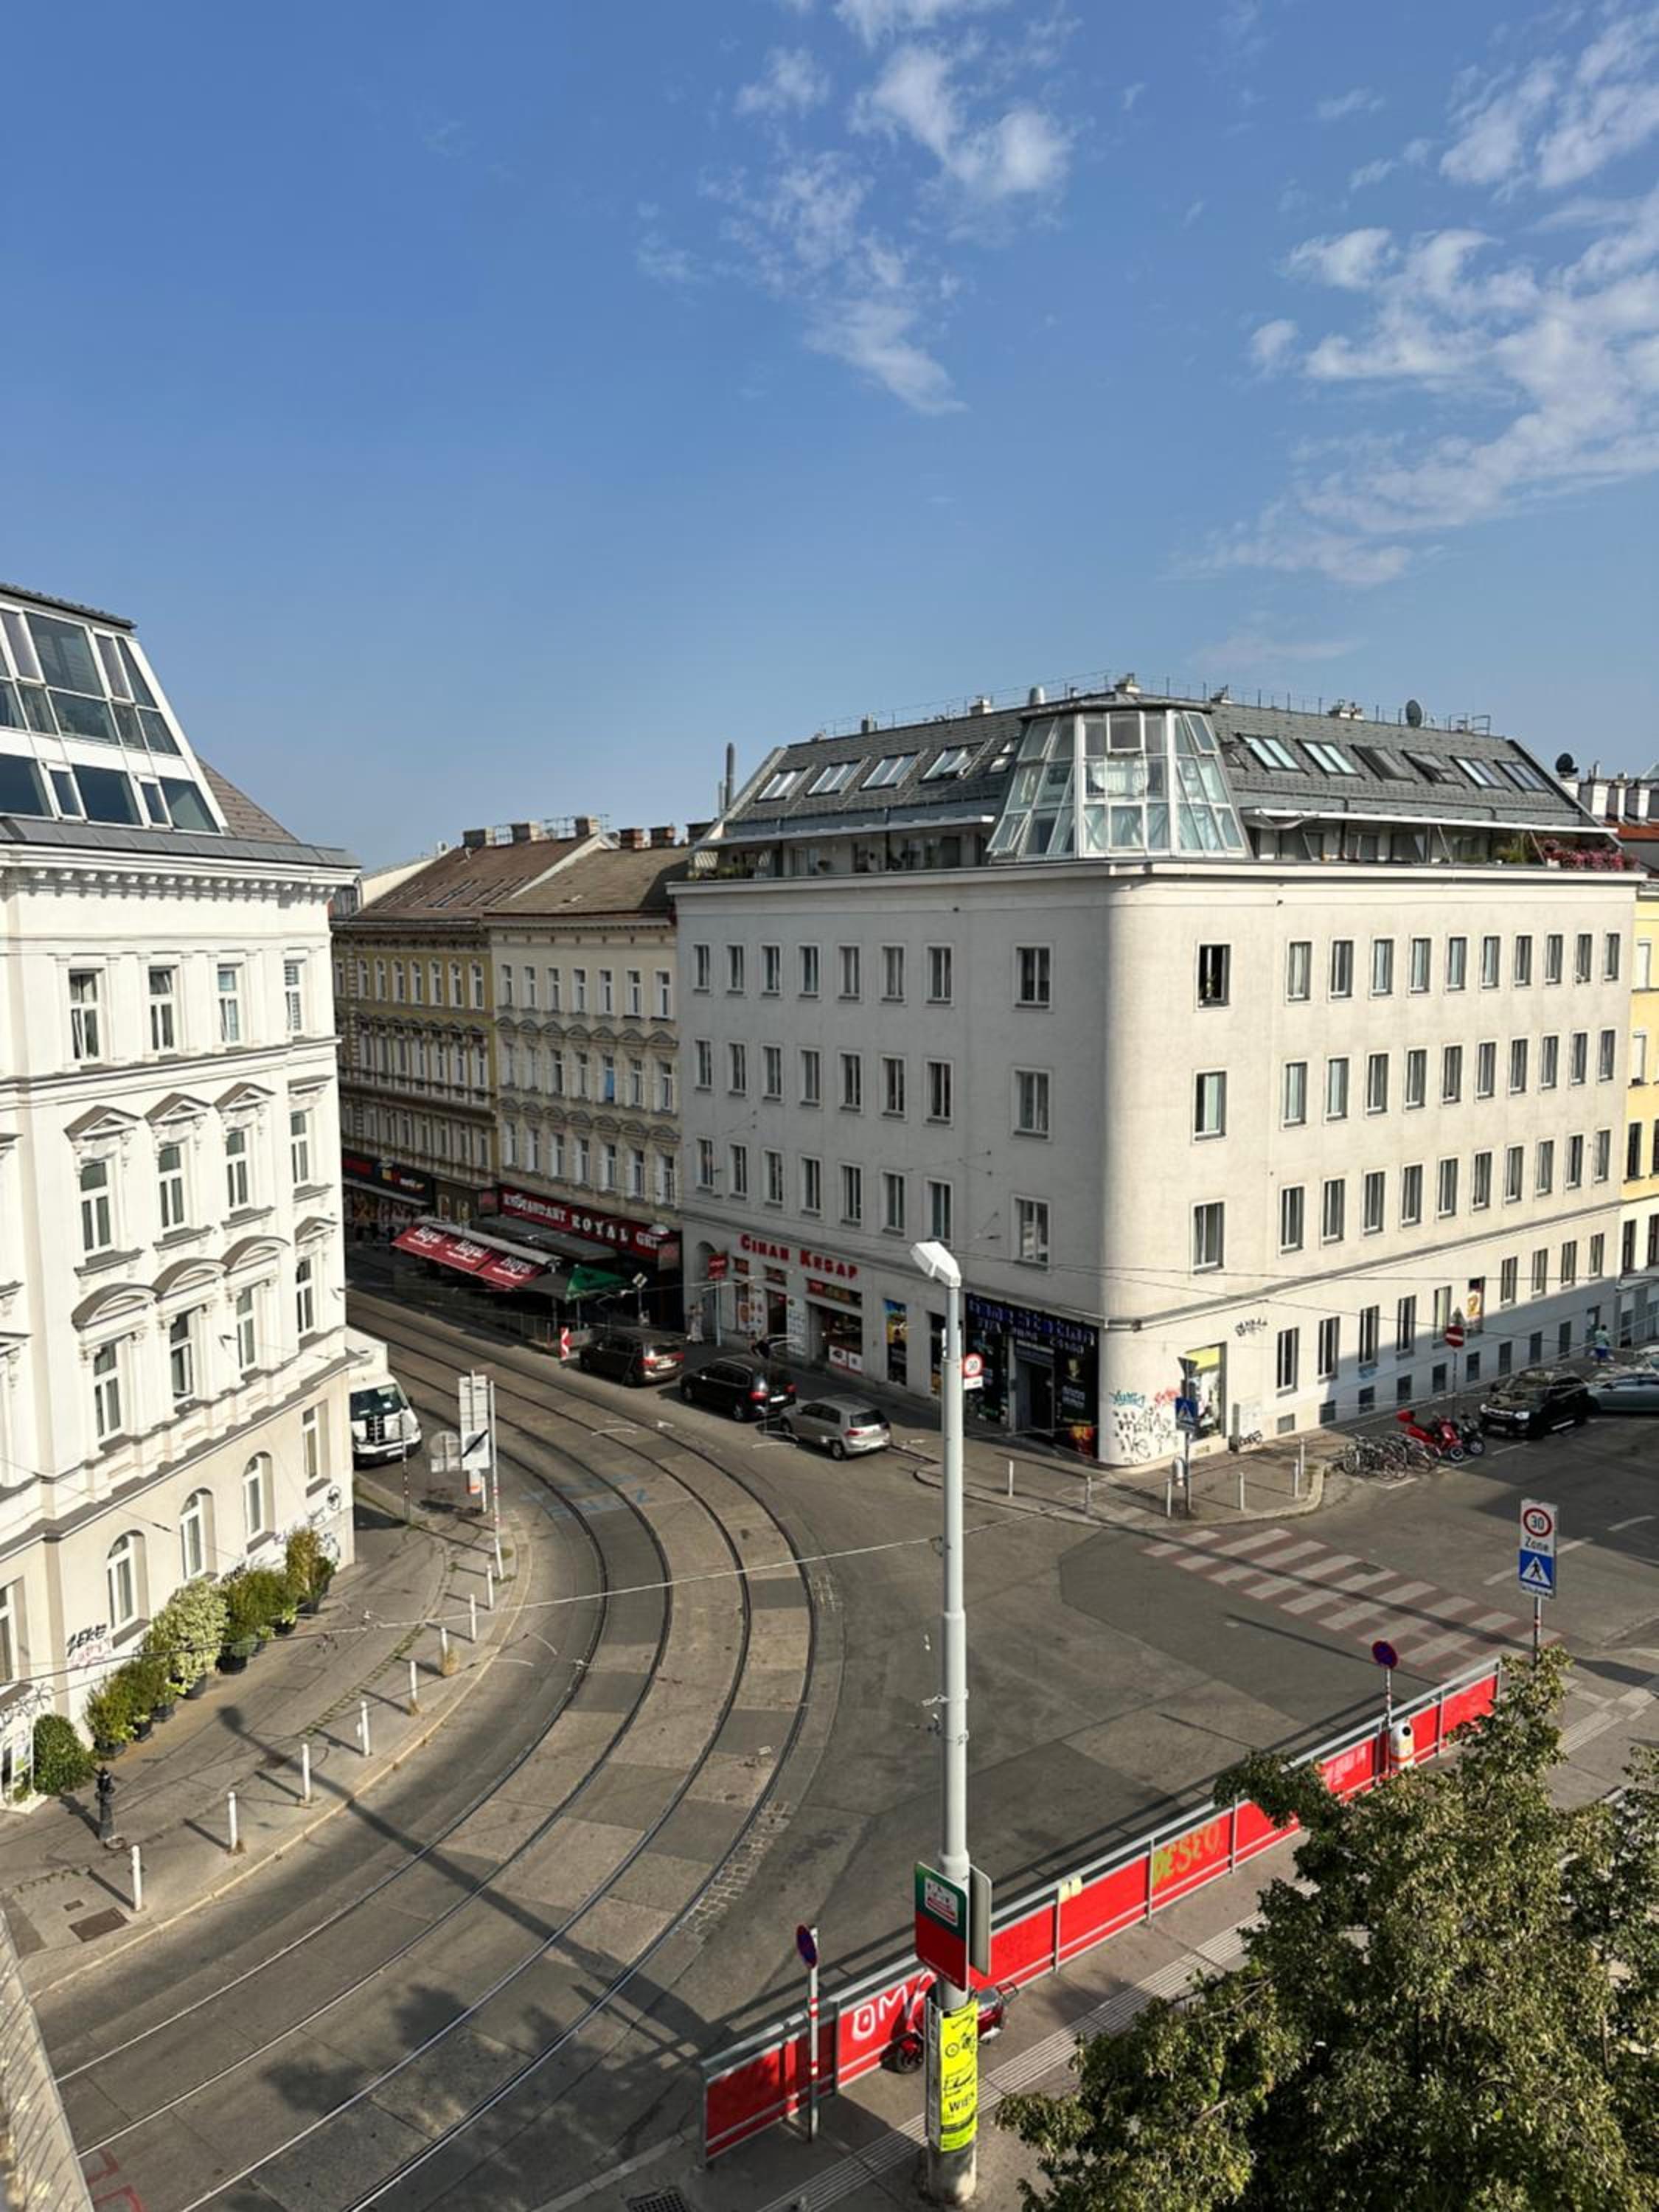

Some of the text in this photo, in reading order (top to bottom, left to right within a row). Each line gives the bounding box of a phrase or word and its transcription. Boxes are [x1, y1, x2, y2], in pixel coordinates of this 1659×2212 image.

[571, 1214, 628, 1242] ROYAL
[740, 1234, 858, 1280] CIHAN KEBAP
[1531, 1514, 1545, 1531] 30
[1525, 1535, 1549, 1553] Zone
